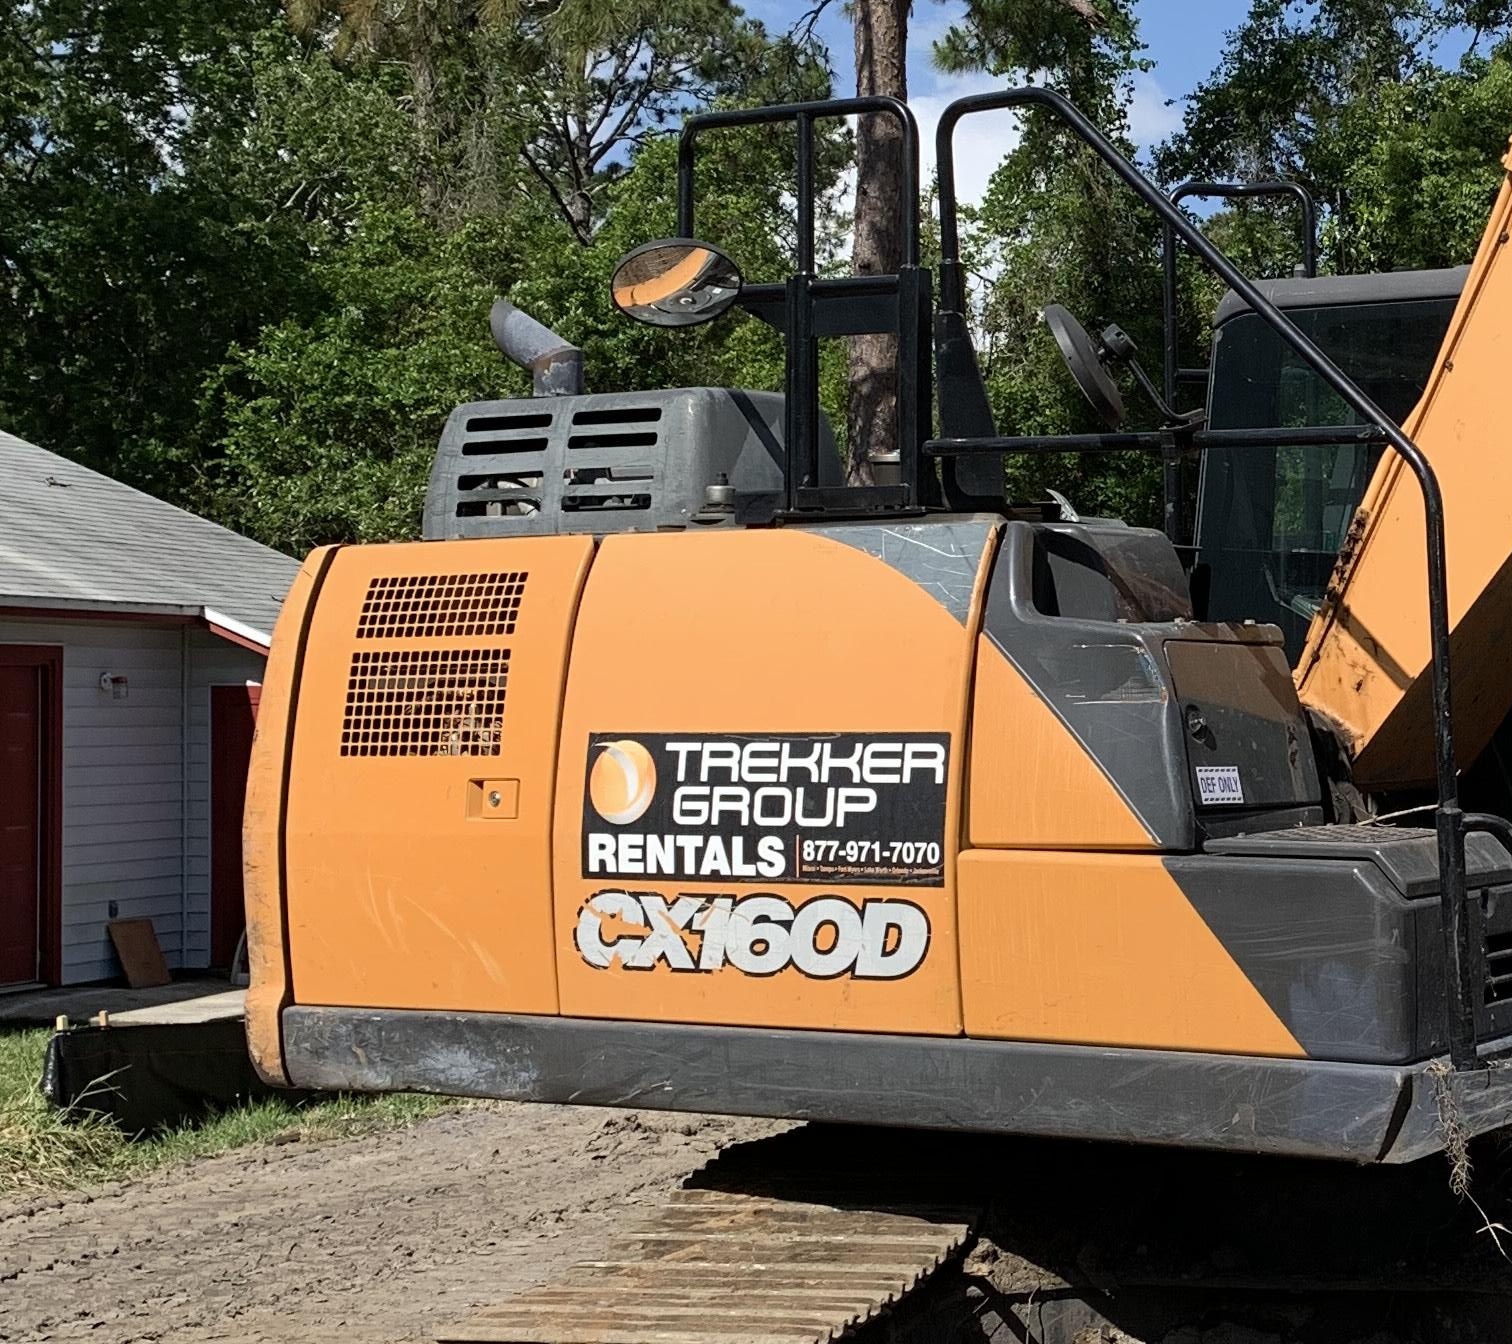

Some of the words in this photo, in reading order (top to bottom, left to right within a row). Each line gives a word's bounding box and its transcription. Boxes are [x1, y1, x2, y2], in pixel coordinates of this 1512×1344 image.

[665, 742, 946, 784] TREKKER
[1200, 776, 1216, 793] DEF
[1218, 776, 1239, 793] ONLY
[672, 786, 877, 827] GROUP
[588, 833, 785, 877] RENTALS
[802, 840, 941, 865] 877-971-7070
[573, 889, 932, 981] CX160D
